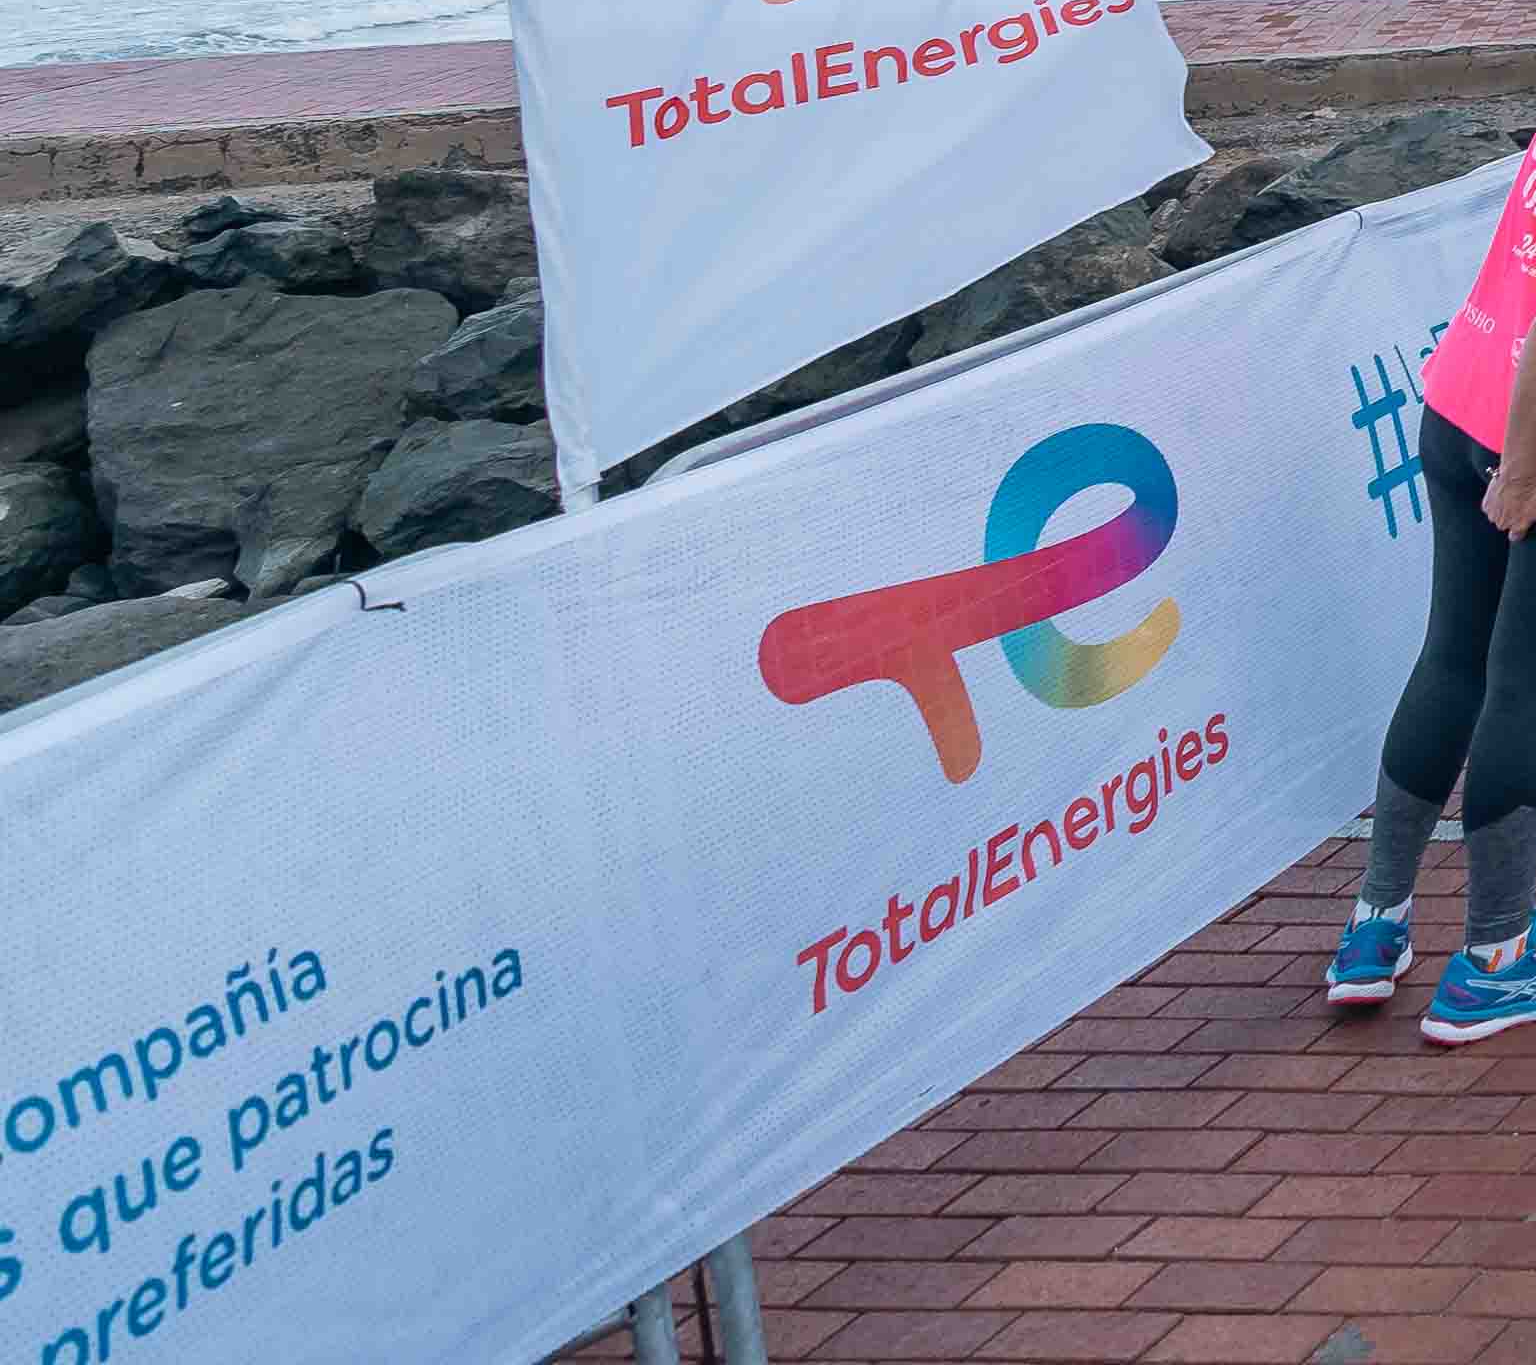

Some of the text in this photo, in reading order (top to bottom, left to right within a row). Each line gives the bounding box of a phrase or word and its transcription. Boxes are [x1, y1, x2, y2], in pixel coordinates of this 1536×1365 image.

[796, 713, 1230, 1015] TotalEnergies
[0, 947, 328, 1163] ompañía
[59, 947, 523, 1254] que patrocina
[41, 1127, 396, 1365] preferidas
